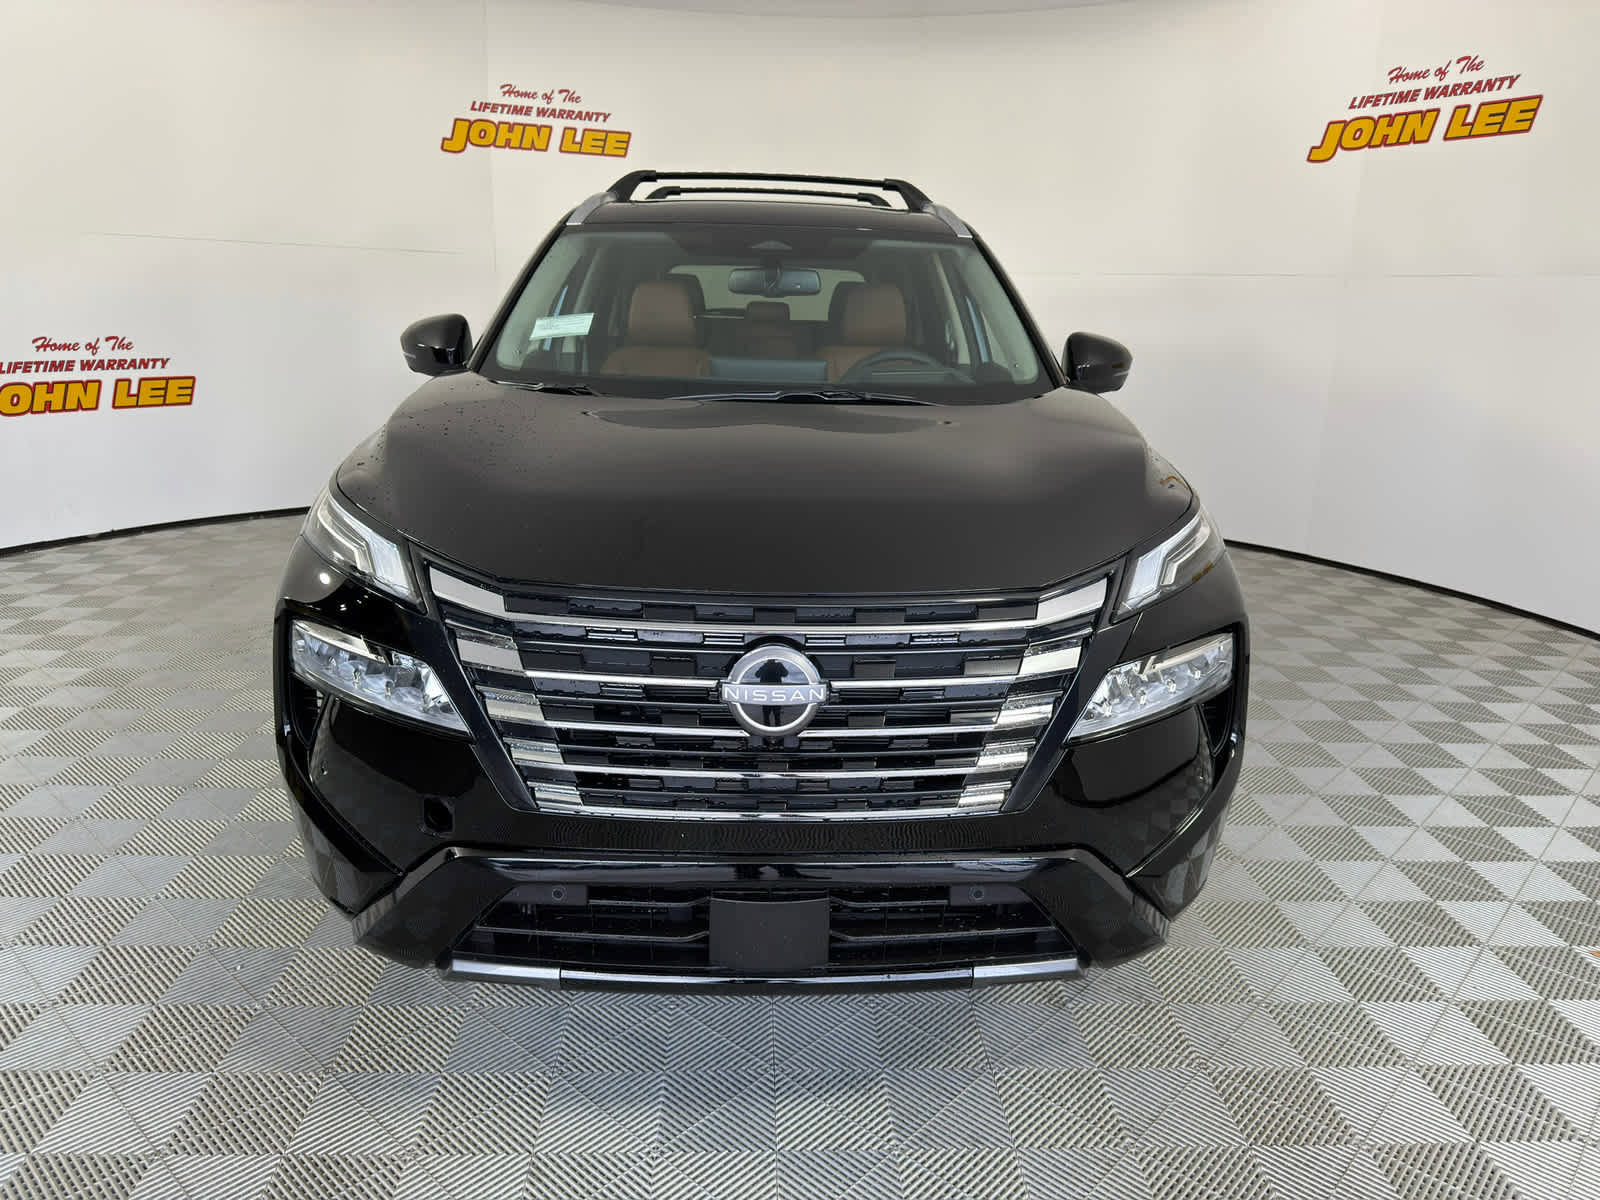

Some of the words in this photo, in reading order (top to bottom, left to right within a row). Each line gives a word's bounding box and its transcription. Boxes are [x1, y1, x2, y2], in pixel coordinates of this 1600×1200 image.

[1388, 66, 1430, 84] Home
[1434, 60, 1452, 81] of
[1456, 55, 1485, 74] The
[500, 83, 537, 100] Home
[541, 89, 554, 104] of
[558, 89, 582, 103] The
[1349, 88, 1421, 109] LIFETIME
[1424, 74, 1521, 100] WARRANTY
[470, 101, 533, 116] LIFETIME
[536, 107, 611, 122] WARRANTY
[441, 118, 552, 153] JOHN
[559, 127, 632, 158] LEE
[1307, 108, 1440, 163] JOHN
[1443, 94, 1544, 141] LEE
[32, 336, 80, 352] Home
[85, 338, 100, 356] of
[105, 336, 133, 351] The
[0, 360, 75, 374] LIFETIME
[80, 358, 169, 371] WARRANTY
[0, 379, 101, 417] OHN
[112, 376, 195, 409] LEE
[724, 687, 824, 702] NISSAN
